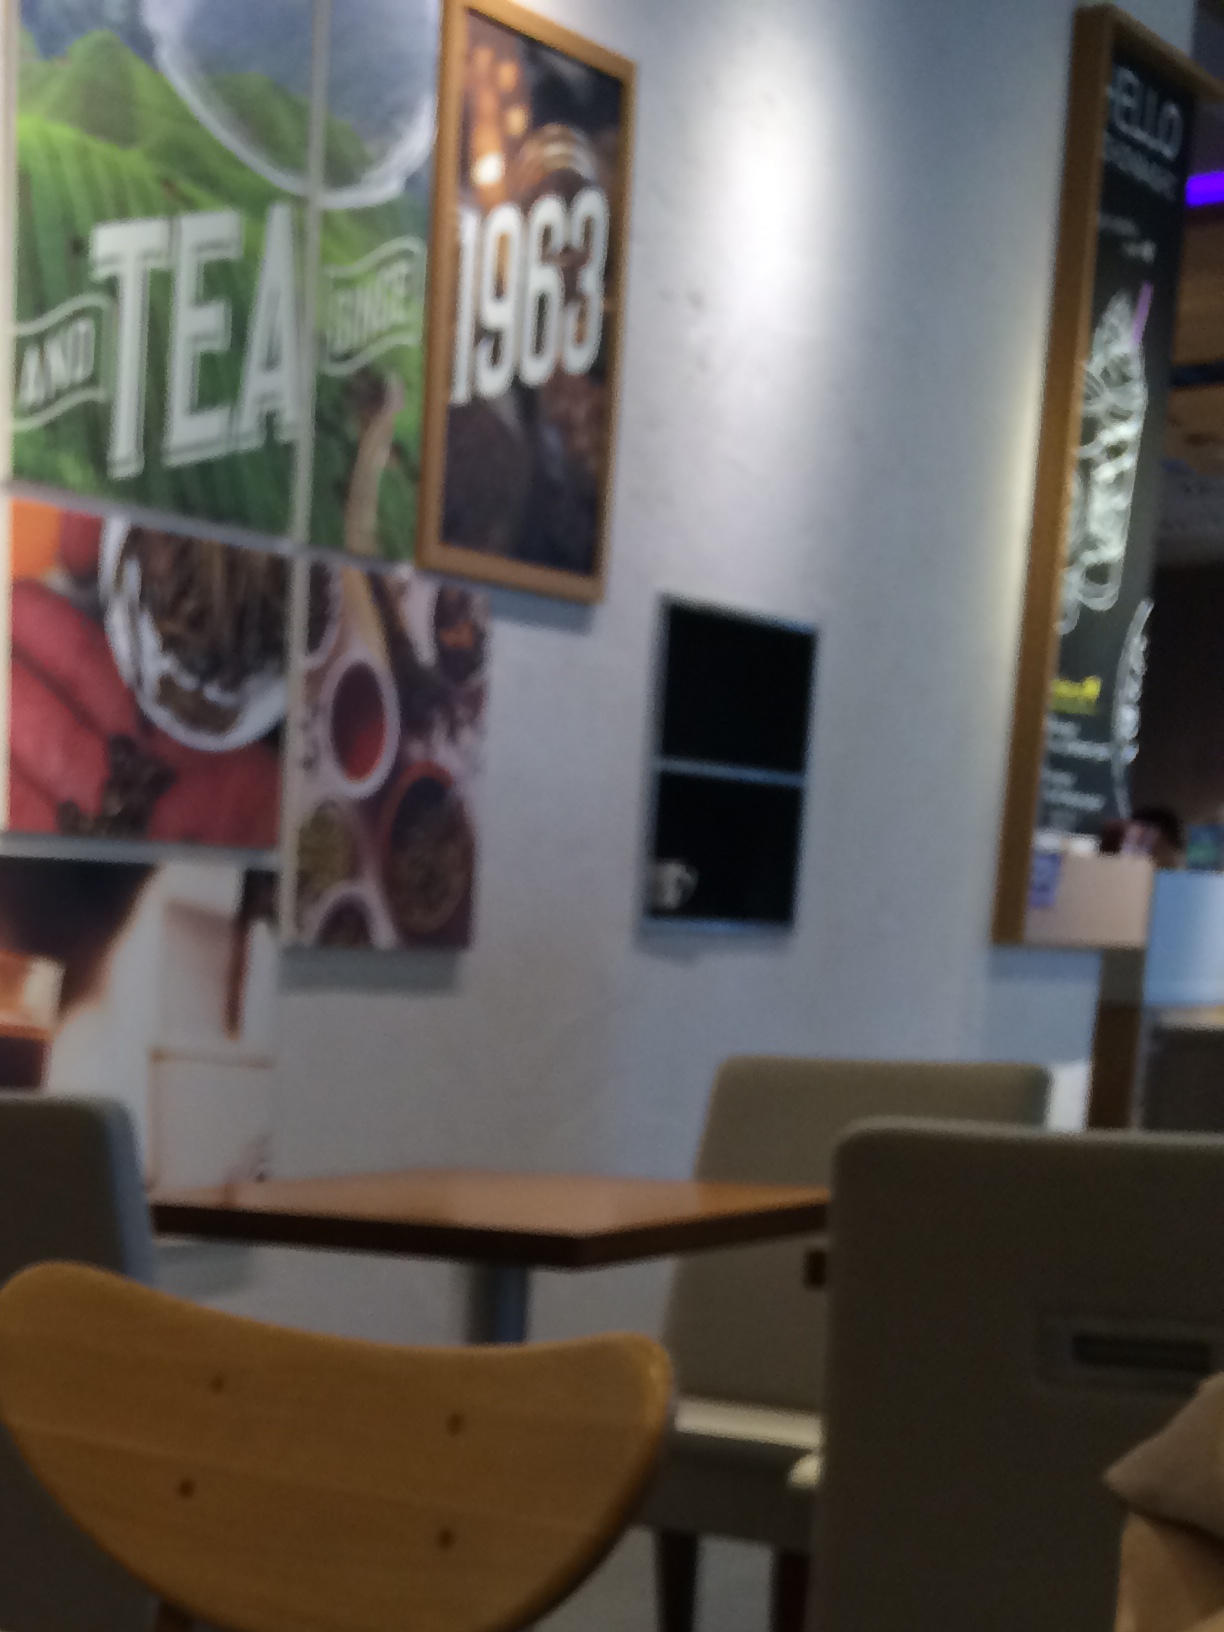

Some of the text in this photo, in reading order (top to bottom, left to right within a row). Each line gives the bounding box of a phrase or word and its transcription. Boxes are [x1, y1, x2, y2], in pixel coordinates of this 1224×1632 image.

[17, 319, 95, 408] AND
[90, 201, 306, 481] TEA
[450, 188, 610, 406] 1963
